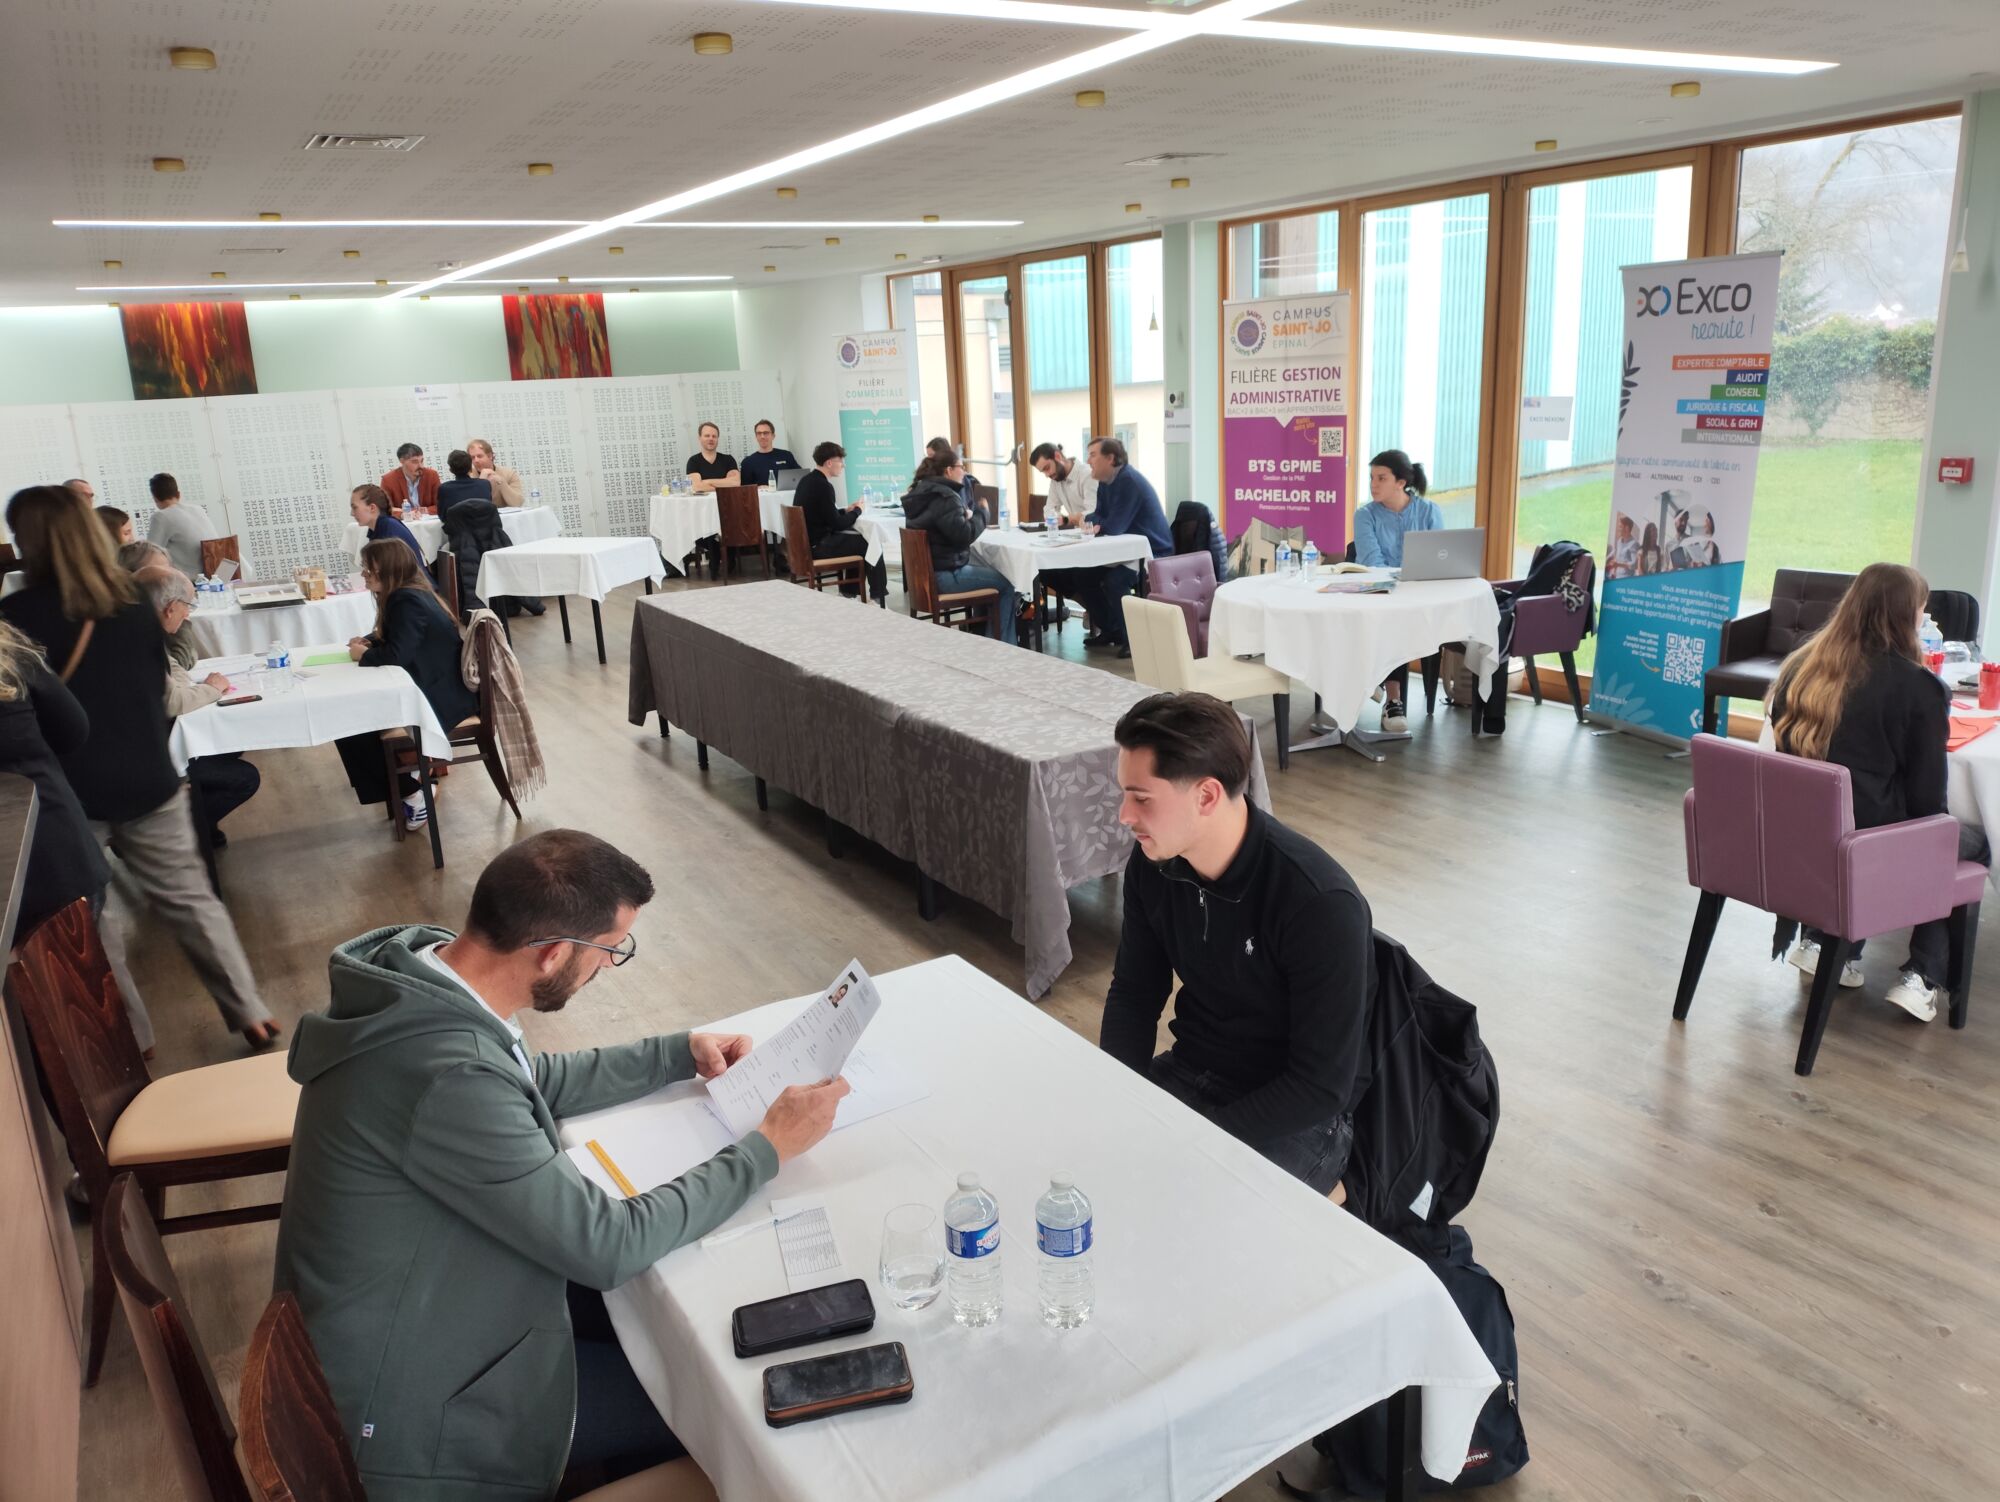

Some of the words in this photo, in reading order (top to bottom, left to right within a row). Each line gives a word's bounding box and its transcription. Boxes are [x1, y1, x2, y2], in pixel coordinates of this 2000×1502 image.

[1272, 306, 1332, 321] CAMPUS
[1272, 320, 1332, 337] SAINT-JO
[1691, 316, 1745, 340] recrute
[862, 338, 897, 347] CAMPUS
[863, 347, 897, 357] SAINT-JO
[1677, 359, 1716, 368] EXPERTISE
[1717, 358, 1765, 368] COMPTABLE
[1231, 366, 1278, 384] FILIÈRE
[1282, 366, 1342, 382] GESTION
[1736, 373, 1763, 383] AUDIT
[846, 388, 903, 399] COMMERCIALE
[1230, 388, 1342, 405] ADMINISTRATIVE
[1725, 388, 1761, 398] CONSEIL
[1686, 402, 1720, 413] JURIDIQUE
[1721, 403, 1727, 412] &
[1729, 403, 1759, 413] FISCAL
[1706, 418, 1729, 427] SOCIAL
[1730, 418, 1737, 428] &
[1738, 418, 1758, 429] GRH
[1697, 433, 1756, 444] INTERNATIONAL
[1248, 459, 1276, 473] BTS
[1280, 459, 1322, 473] GPME
[1234, 488, 1311, 503] BACHELOR
[1315, 490, 1337, 504] RH
